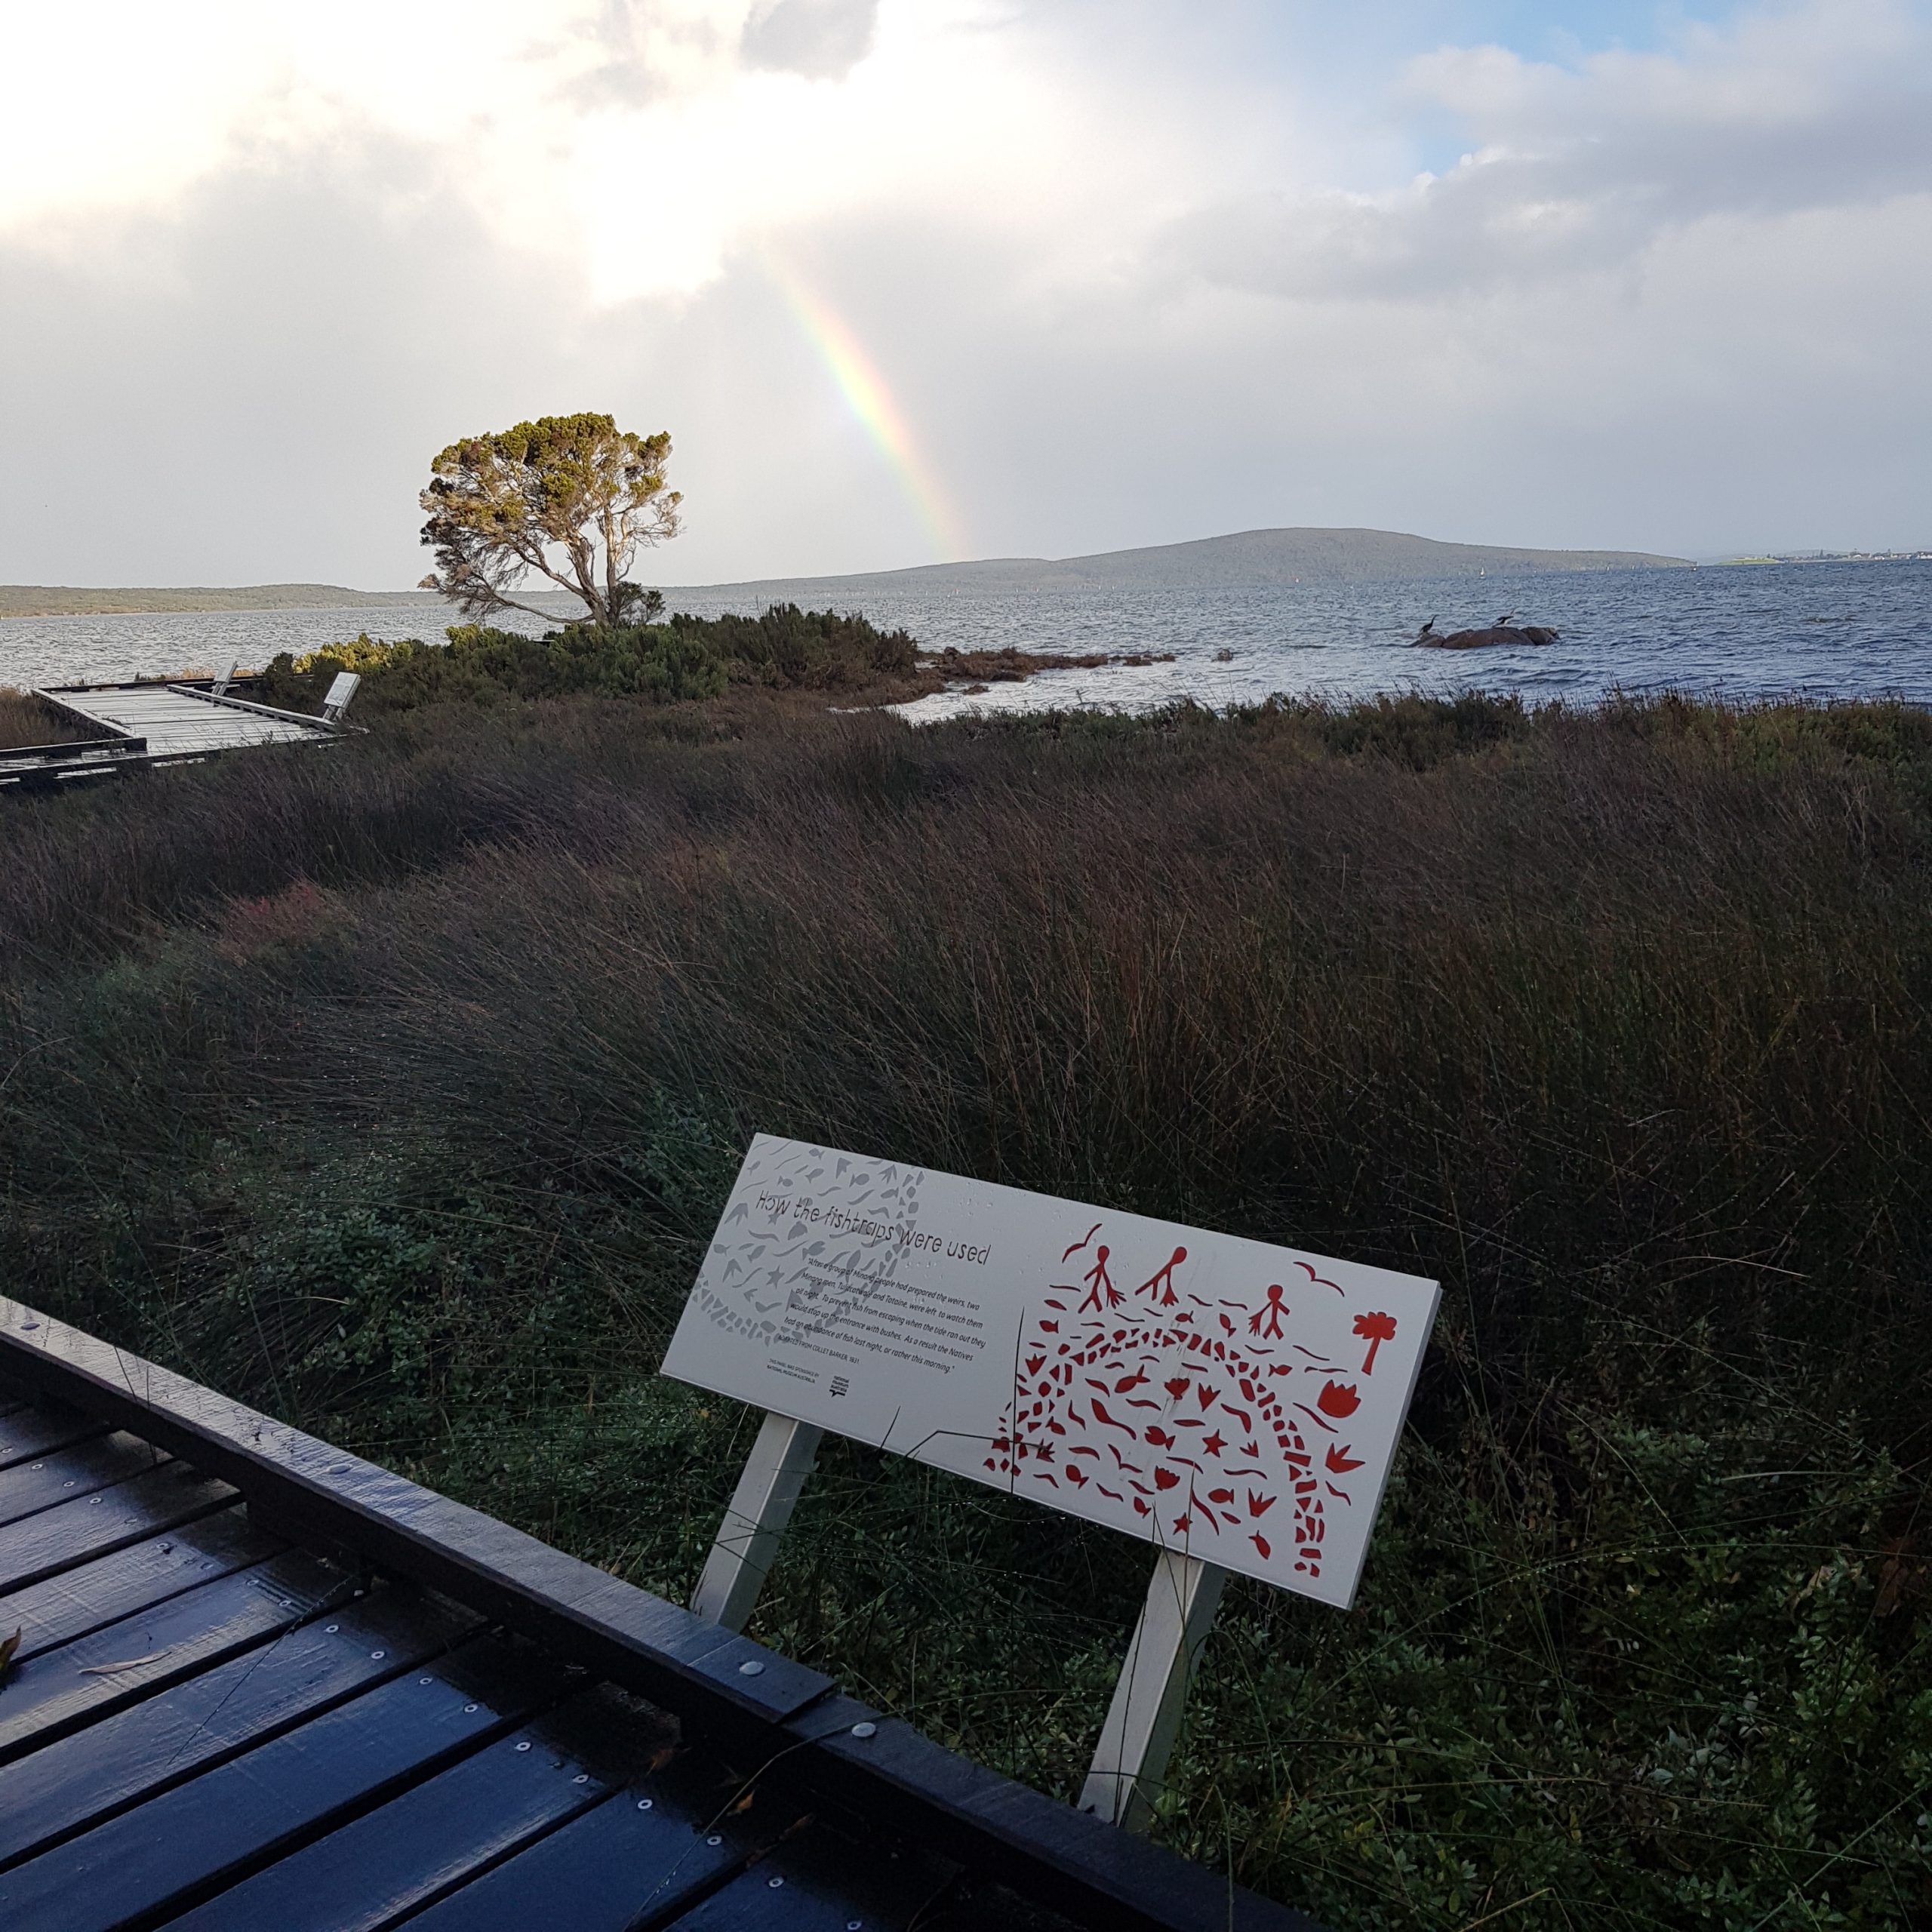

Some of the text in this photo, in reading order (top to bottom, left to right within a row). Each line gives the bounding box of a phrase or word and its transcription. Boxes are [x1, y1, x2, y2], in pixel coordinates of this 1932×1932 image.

[756, 1190, 992, 1265] How the fishtraps were used
[828, 1265, 844, 1275] group
[875, 1277, 894, 1288] people
[908, 1285, 935, 1300] prepared
[968, 1301, 980, 1309] two
[790, 1302, 807, 1312] would
[808, 1307, 820, 1317] stop
[840, 1318, 865, 1328] entrance
[866, 1324, 879, 1333] with
[919, 1340, 937, 1349] result
[938, 1345, 948, 1353] the
[949, 1349, 973, 1360] Natives
[878, 1312, 904, 1325] escaping
[906, 1319, 921, 1327] when
[934, 1327, 946, 1335] tide
[971, 1337, 986, 1349] they
[946, 1312, 965, 1323] watch
[967, 1318, 983, 1327] them
[854, 1337, 865, 1346] last
[891, 1349, 910, 1359] rather
[912, 1355, 923, 1363] this
